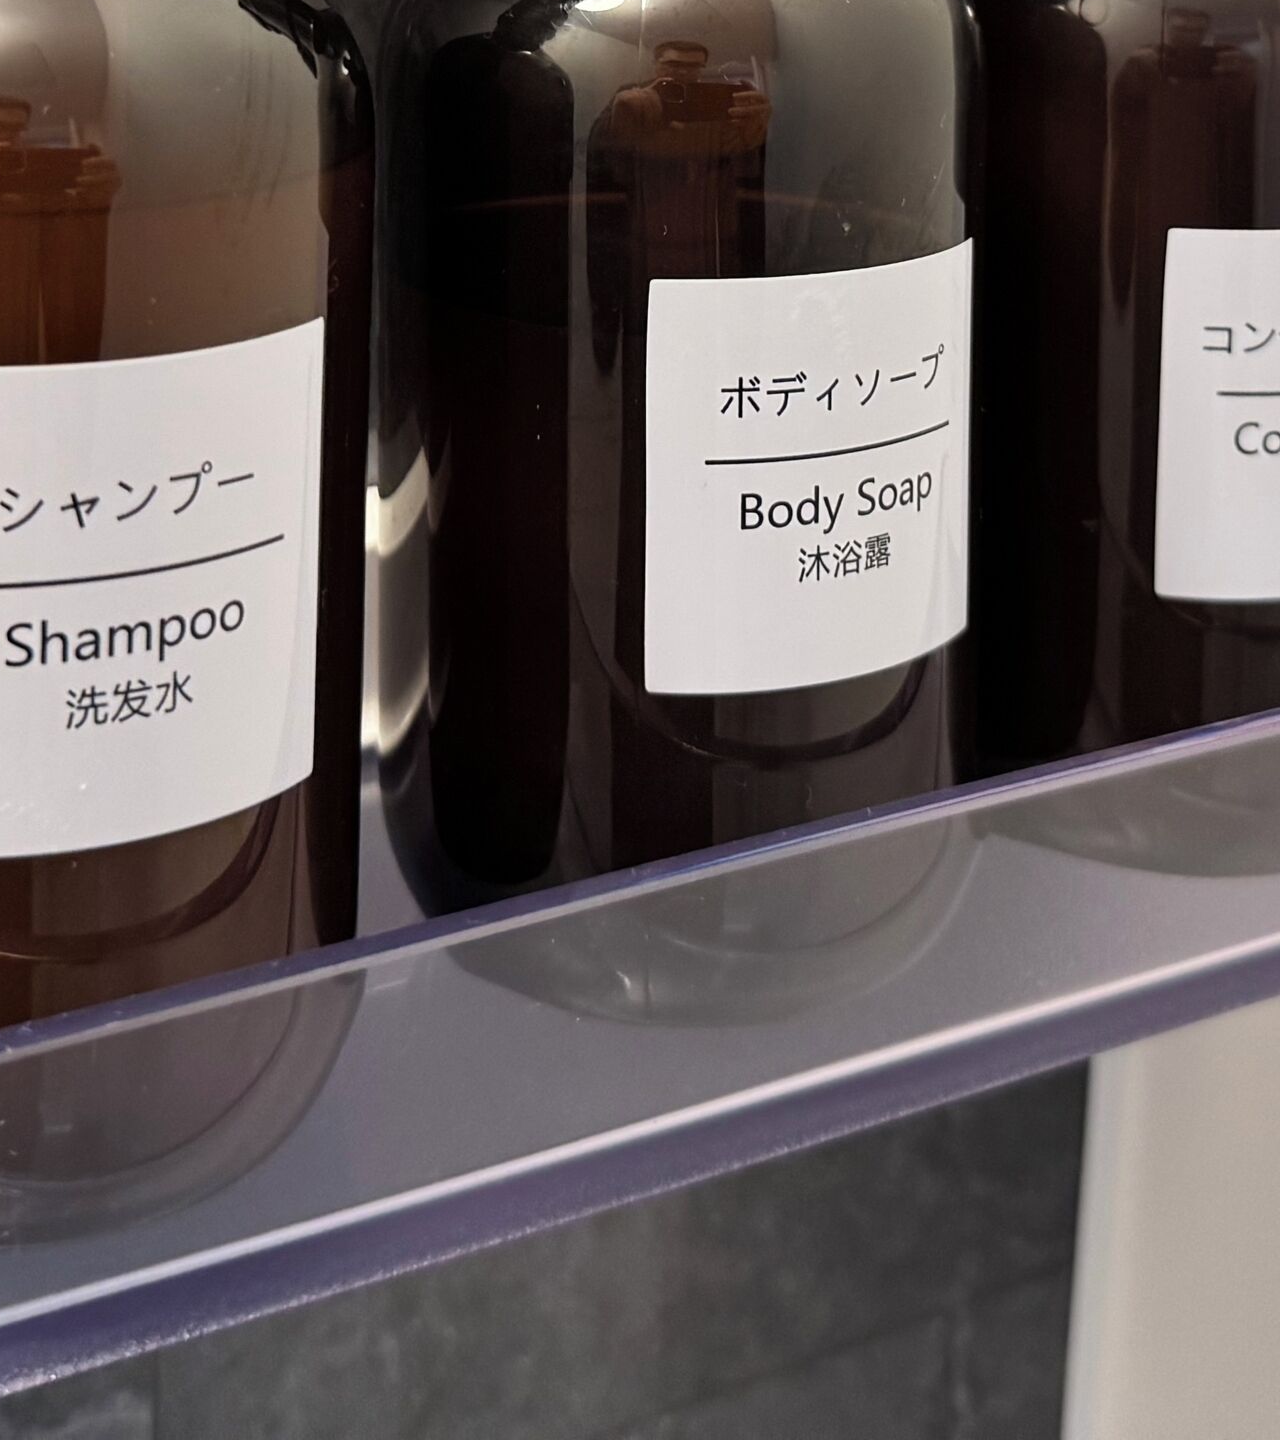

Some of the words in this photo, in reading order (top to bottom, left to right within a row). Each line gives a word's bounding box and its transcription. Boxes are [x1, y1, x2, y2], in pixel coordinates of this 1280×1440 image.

[720, 344, 944, 418] ボディソープ
[0, 461, 254, 532] シャンプー
[740, 485, 844, 534] Body
[857, 471, 932, 516] Soap
[798, 533, 891, 583] 沐浴露
[5, 599, 245, 666] Shampoo
[65, 670, 193, 729] 洗发水
